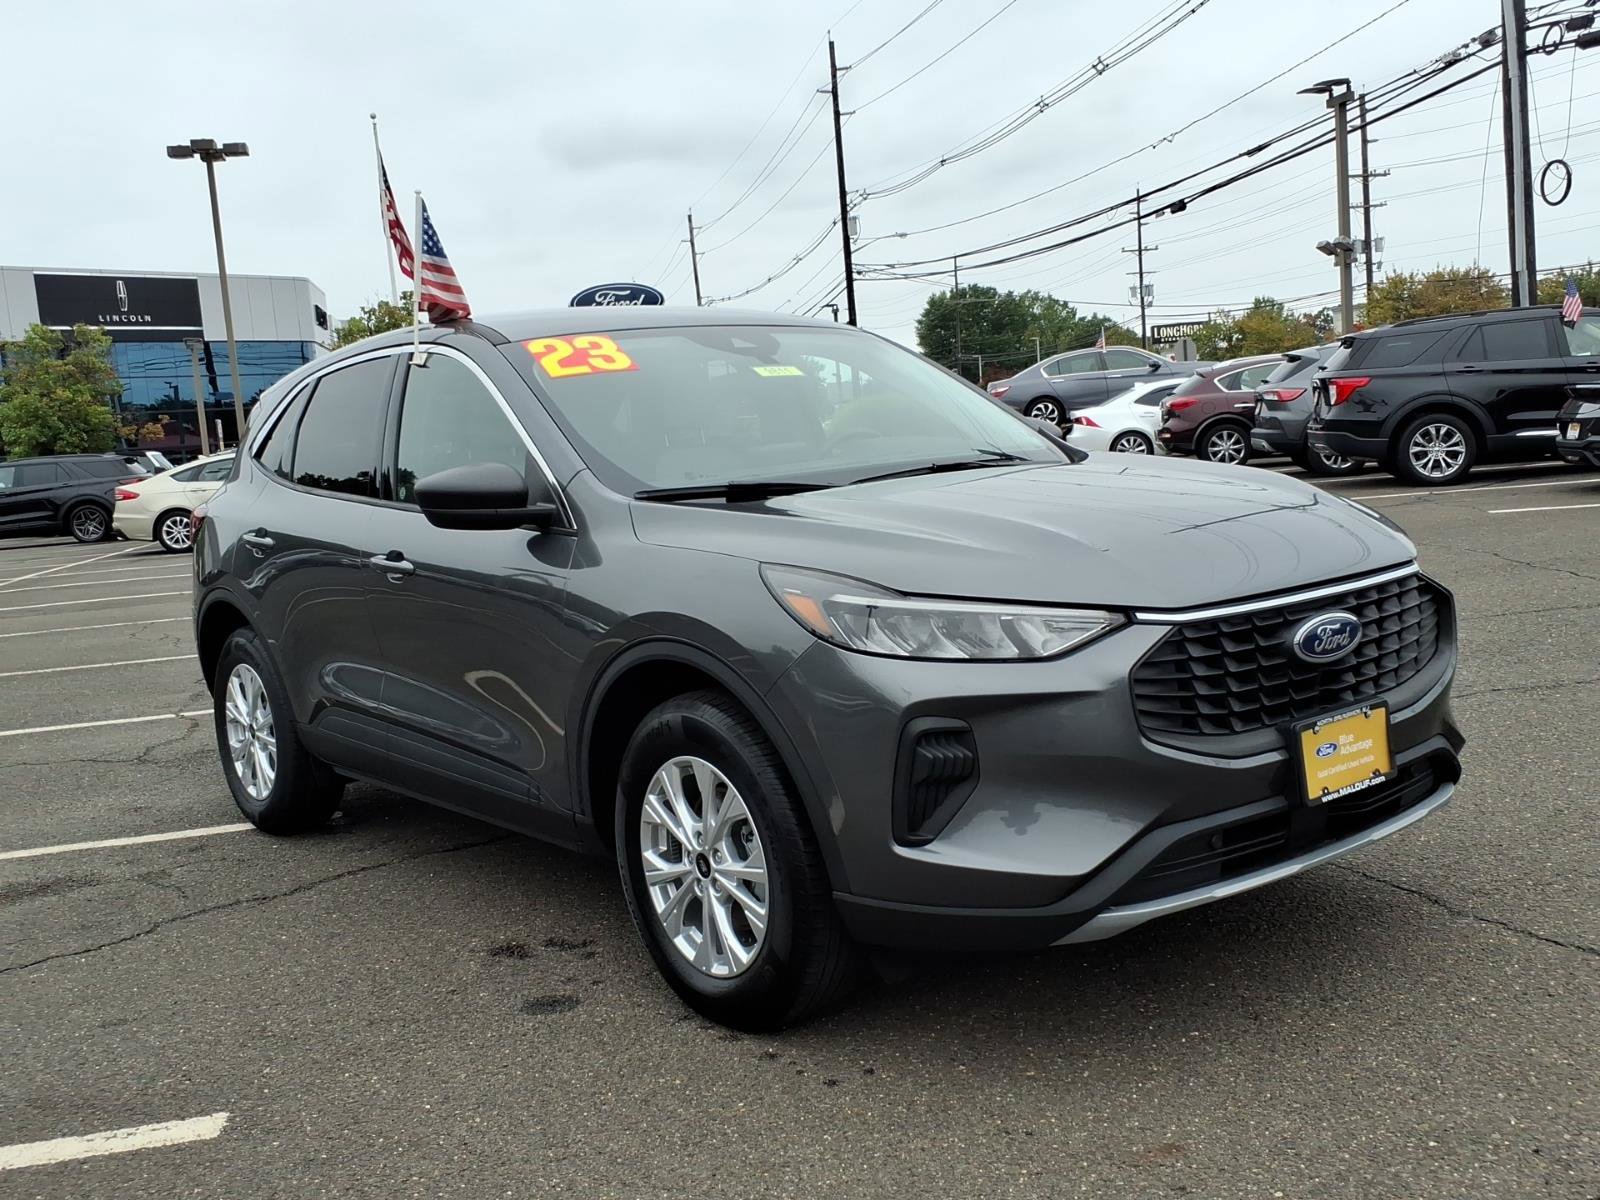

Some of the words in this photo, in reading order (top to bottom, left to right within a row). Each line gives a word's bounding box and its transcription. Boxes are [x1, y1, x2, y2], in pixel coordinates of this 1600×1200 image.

[98, 314, 151, 322] LINCOLN
[527, 335, 632, 378] 23
[1314, 623, 1351, 653] Ford
